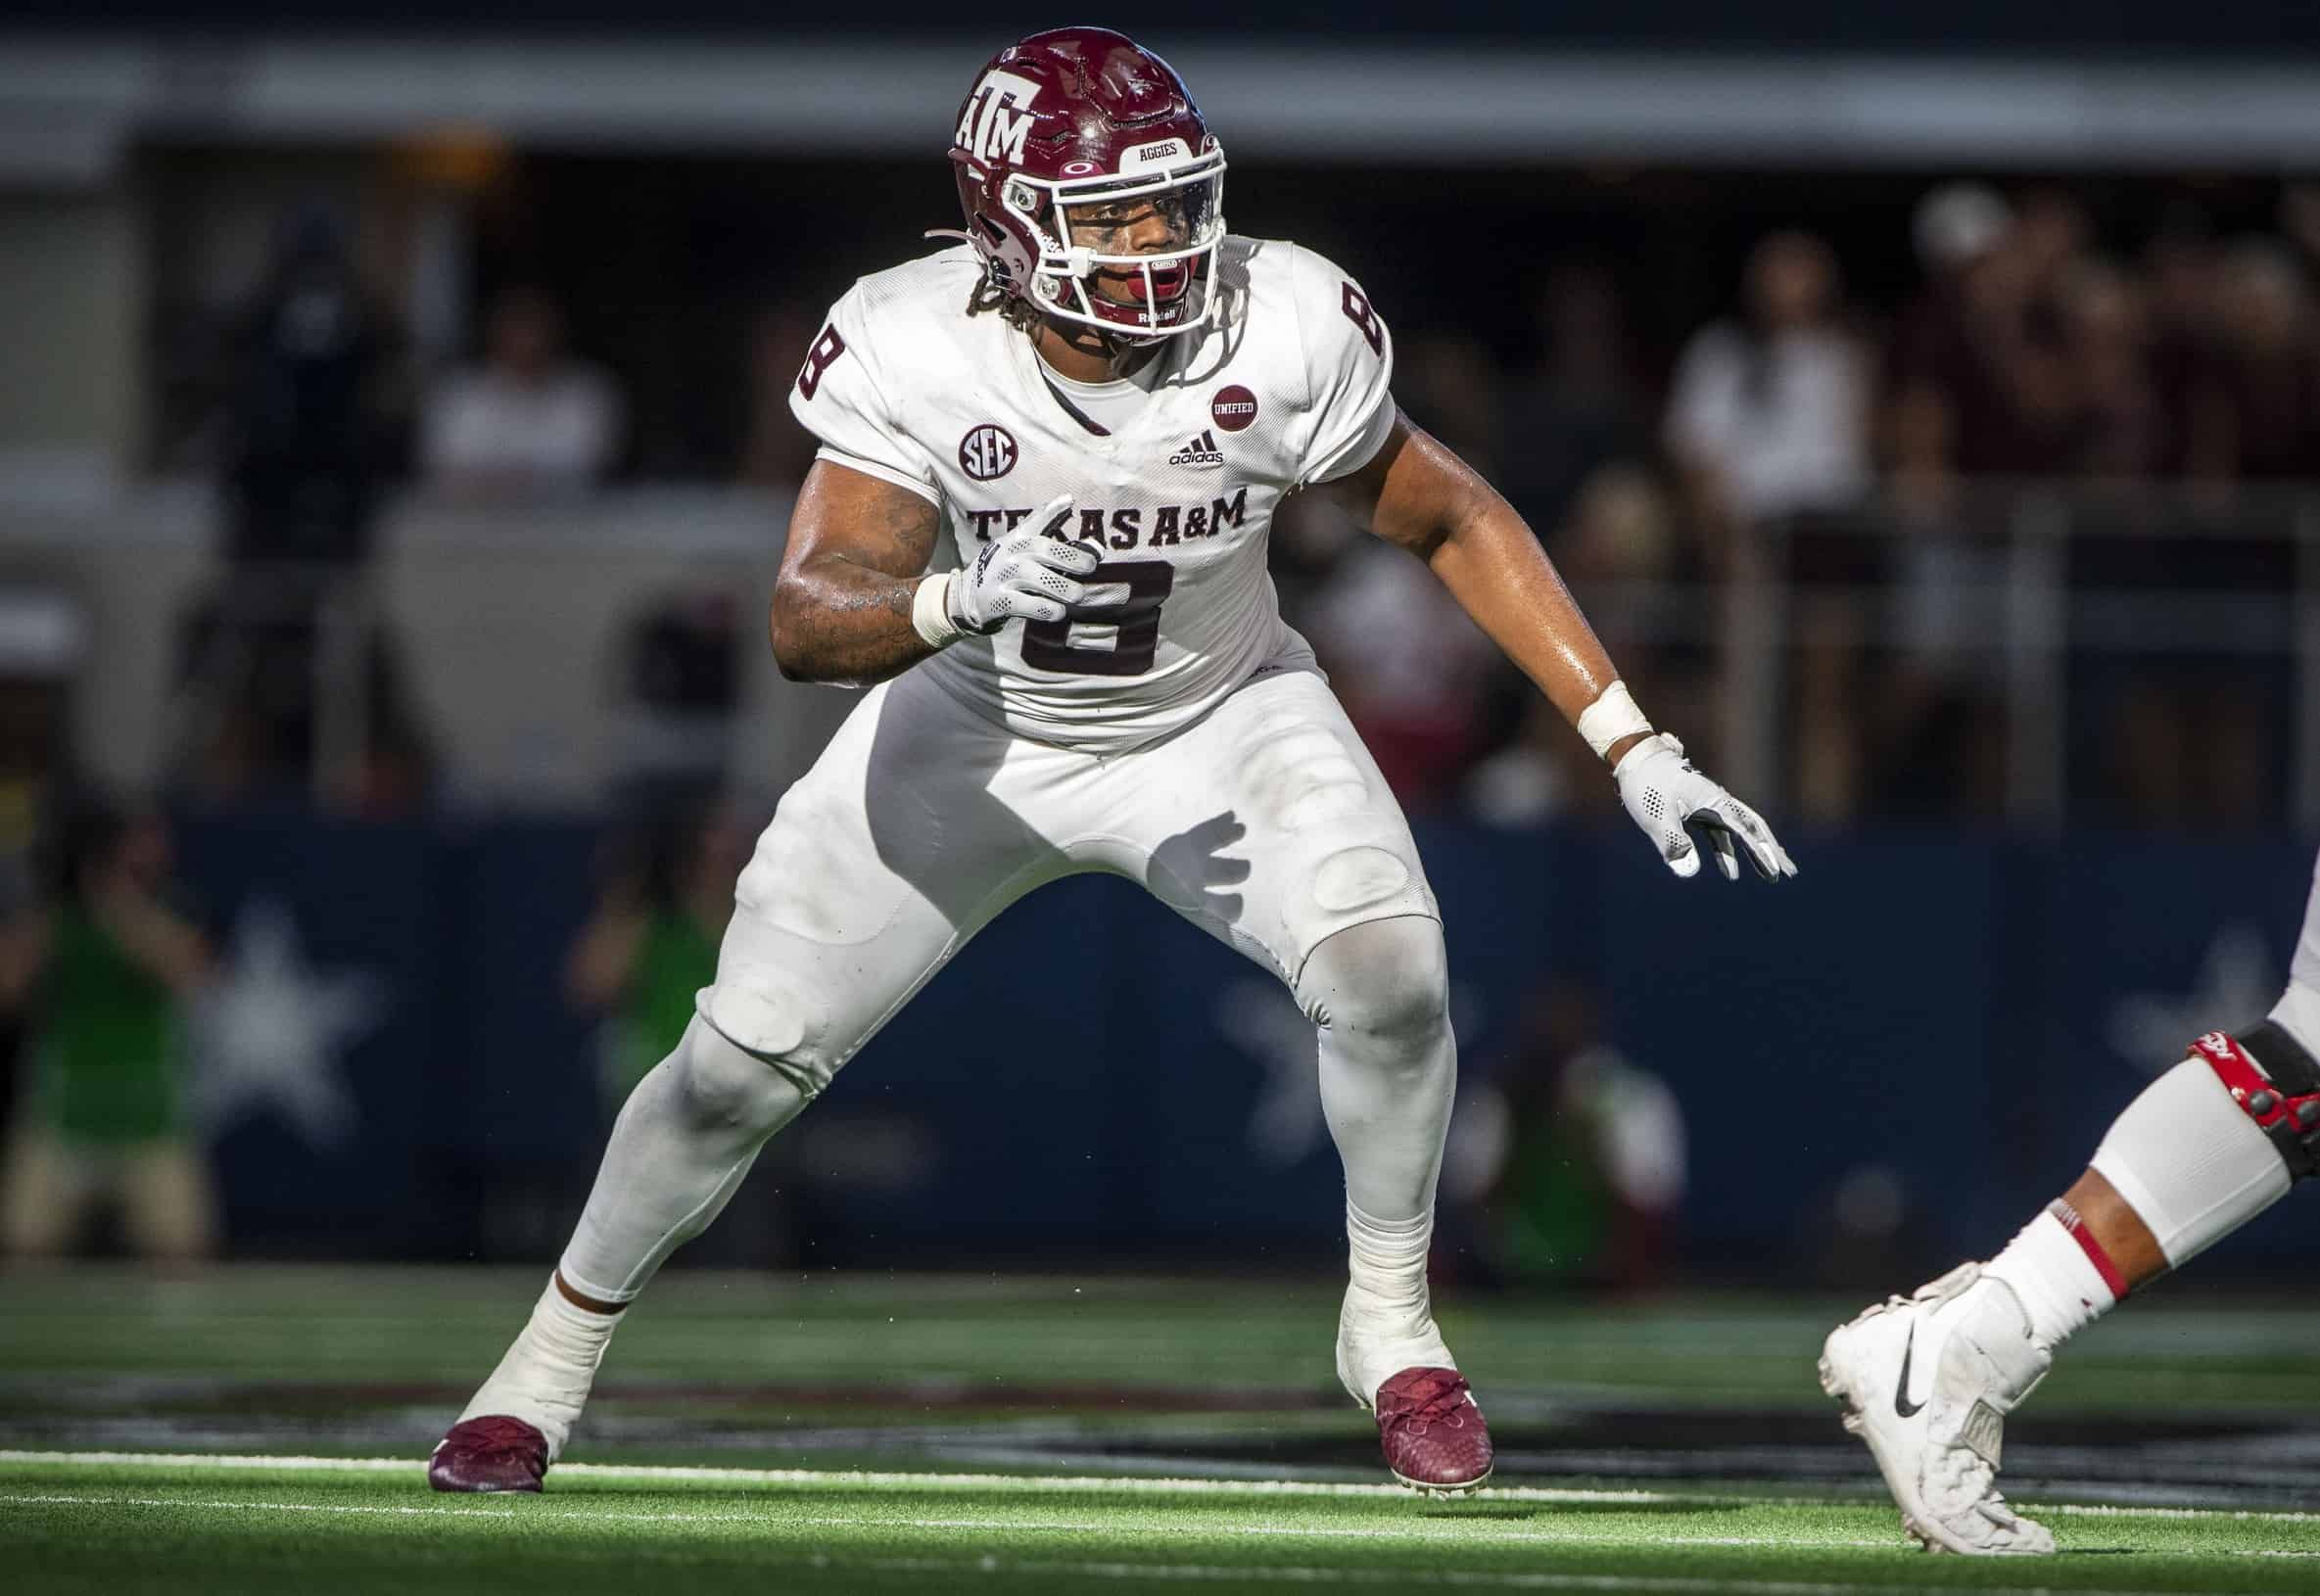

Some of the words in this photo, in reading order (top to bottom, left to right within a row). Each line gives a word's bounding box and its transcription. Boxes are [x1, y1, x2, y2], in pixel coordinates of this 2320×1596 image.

[1139, 142, 1177, 162] AGGIES
[1342, 281, 1383, 356] 8
[798, 322, 845, 400] 8
[1214, 402, 1254, 415] UNIFIED
[963, 429, 1013, 477] SEC
[1169, 450, 1224, 465] adidas
[1148, 488, 1248, 548] A&M
